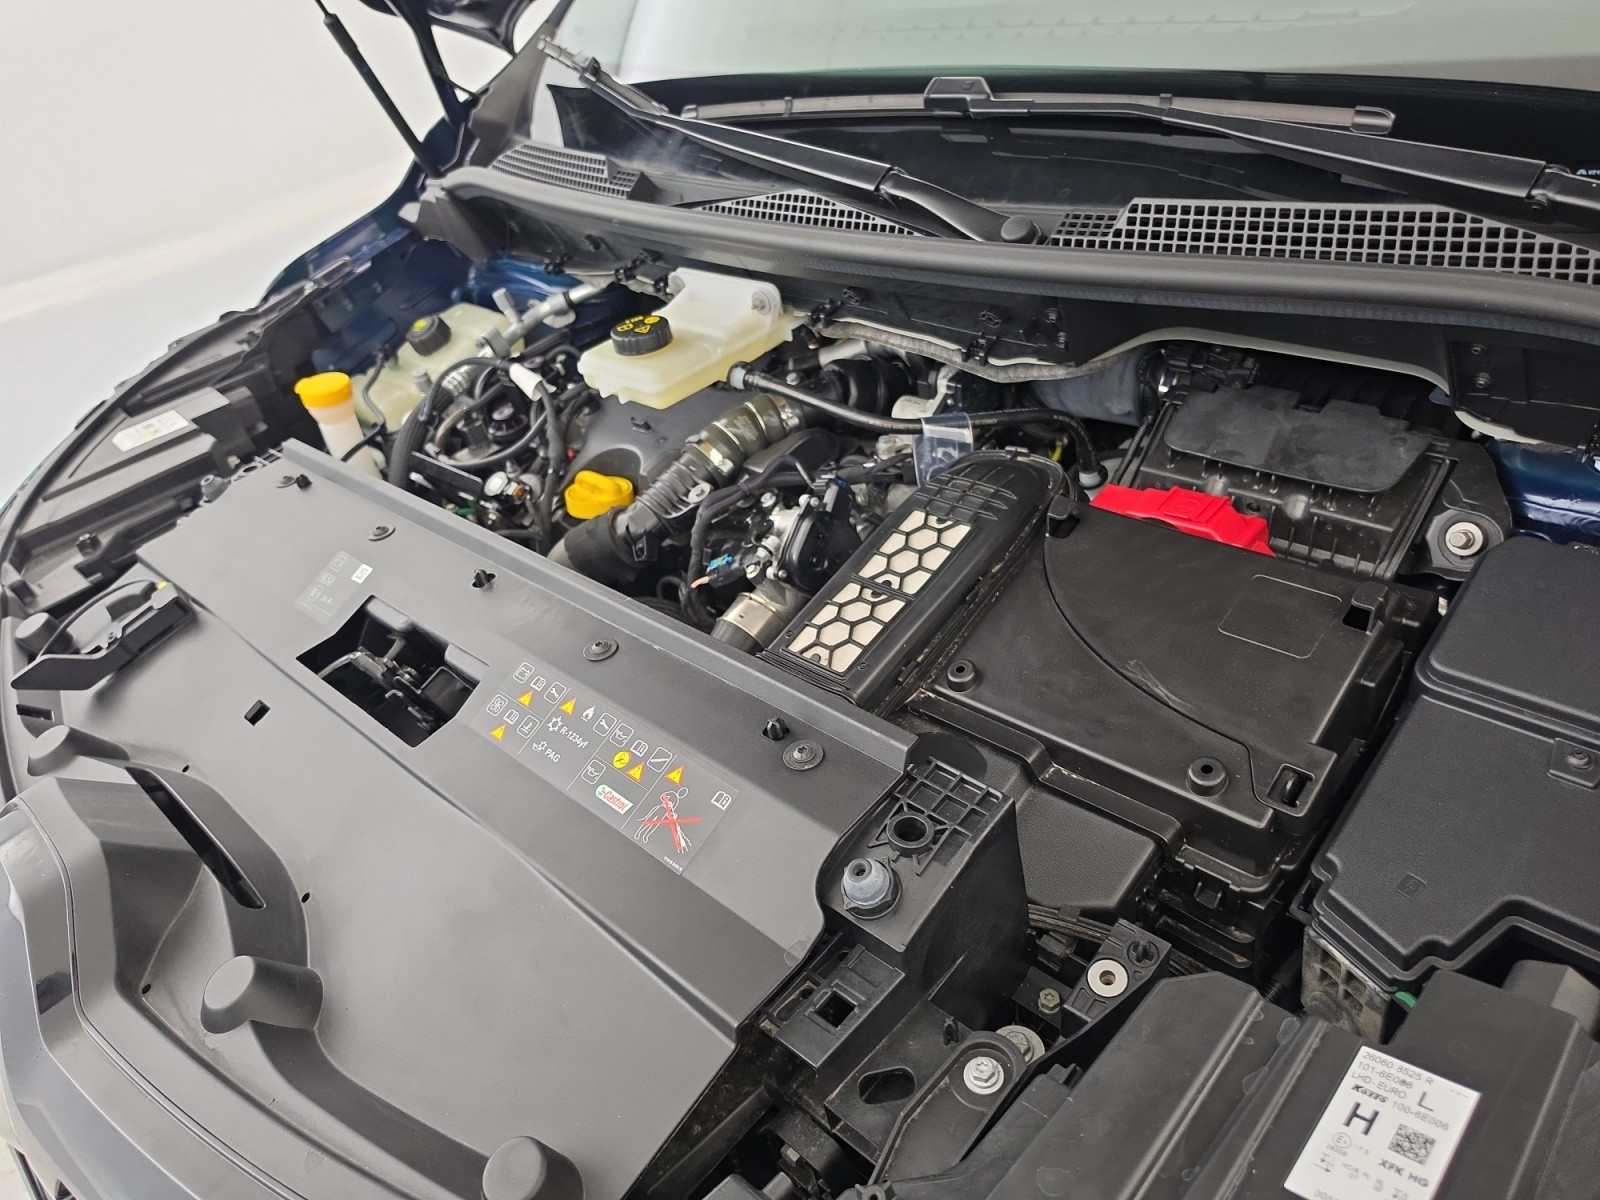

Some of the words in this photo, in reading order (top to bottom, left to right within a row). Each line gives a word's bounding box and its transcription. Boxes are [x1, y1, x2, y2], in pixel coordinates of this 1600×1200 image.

[545, 748, 561, 763] PAG
[602, 790, 629, 811] Castrol
[1362, 1051, 1394, 1069] 26060
[1396, 1065, 1423, 1081] 8525
[1425, 1076, 1435, 1086] R
[1416, 1091, 1434, 1112] L
[1343, 1101, 1380, 1135] H
